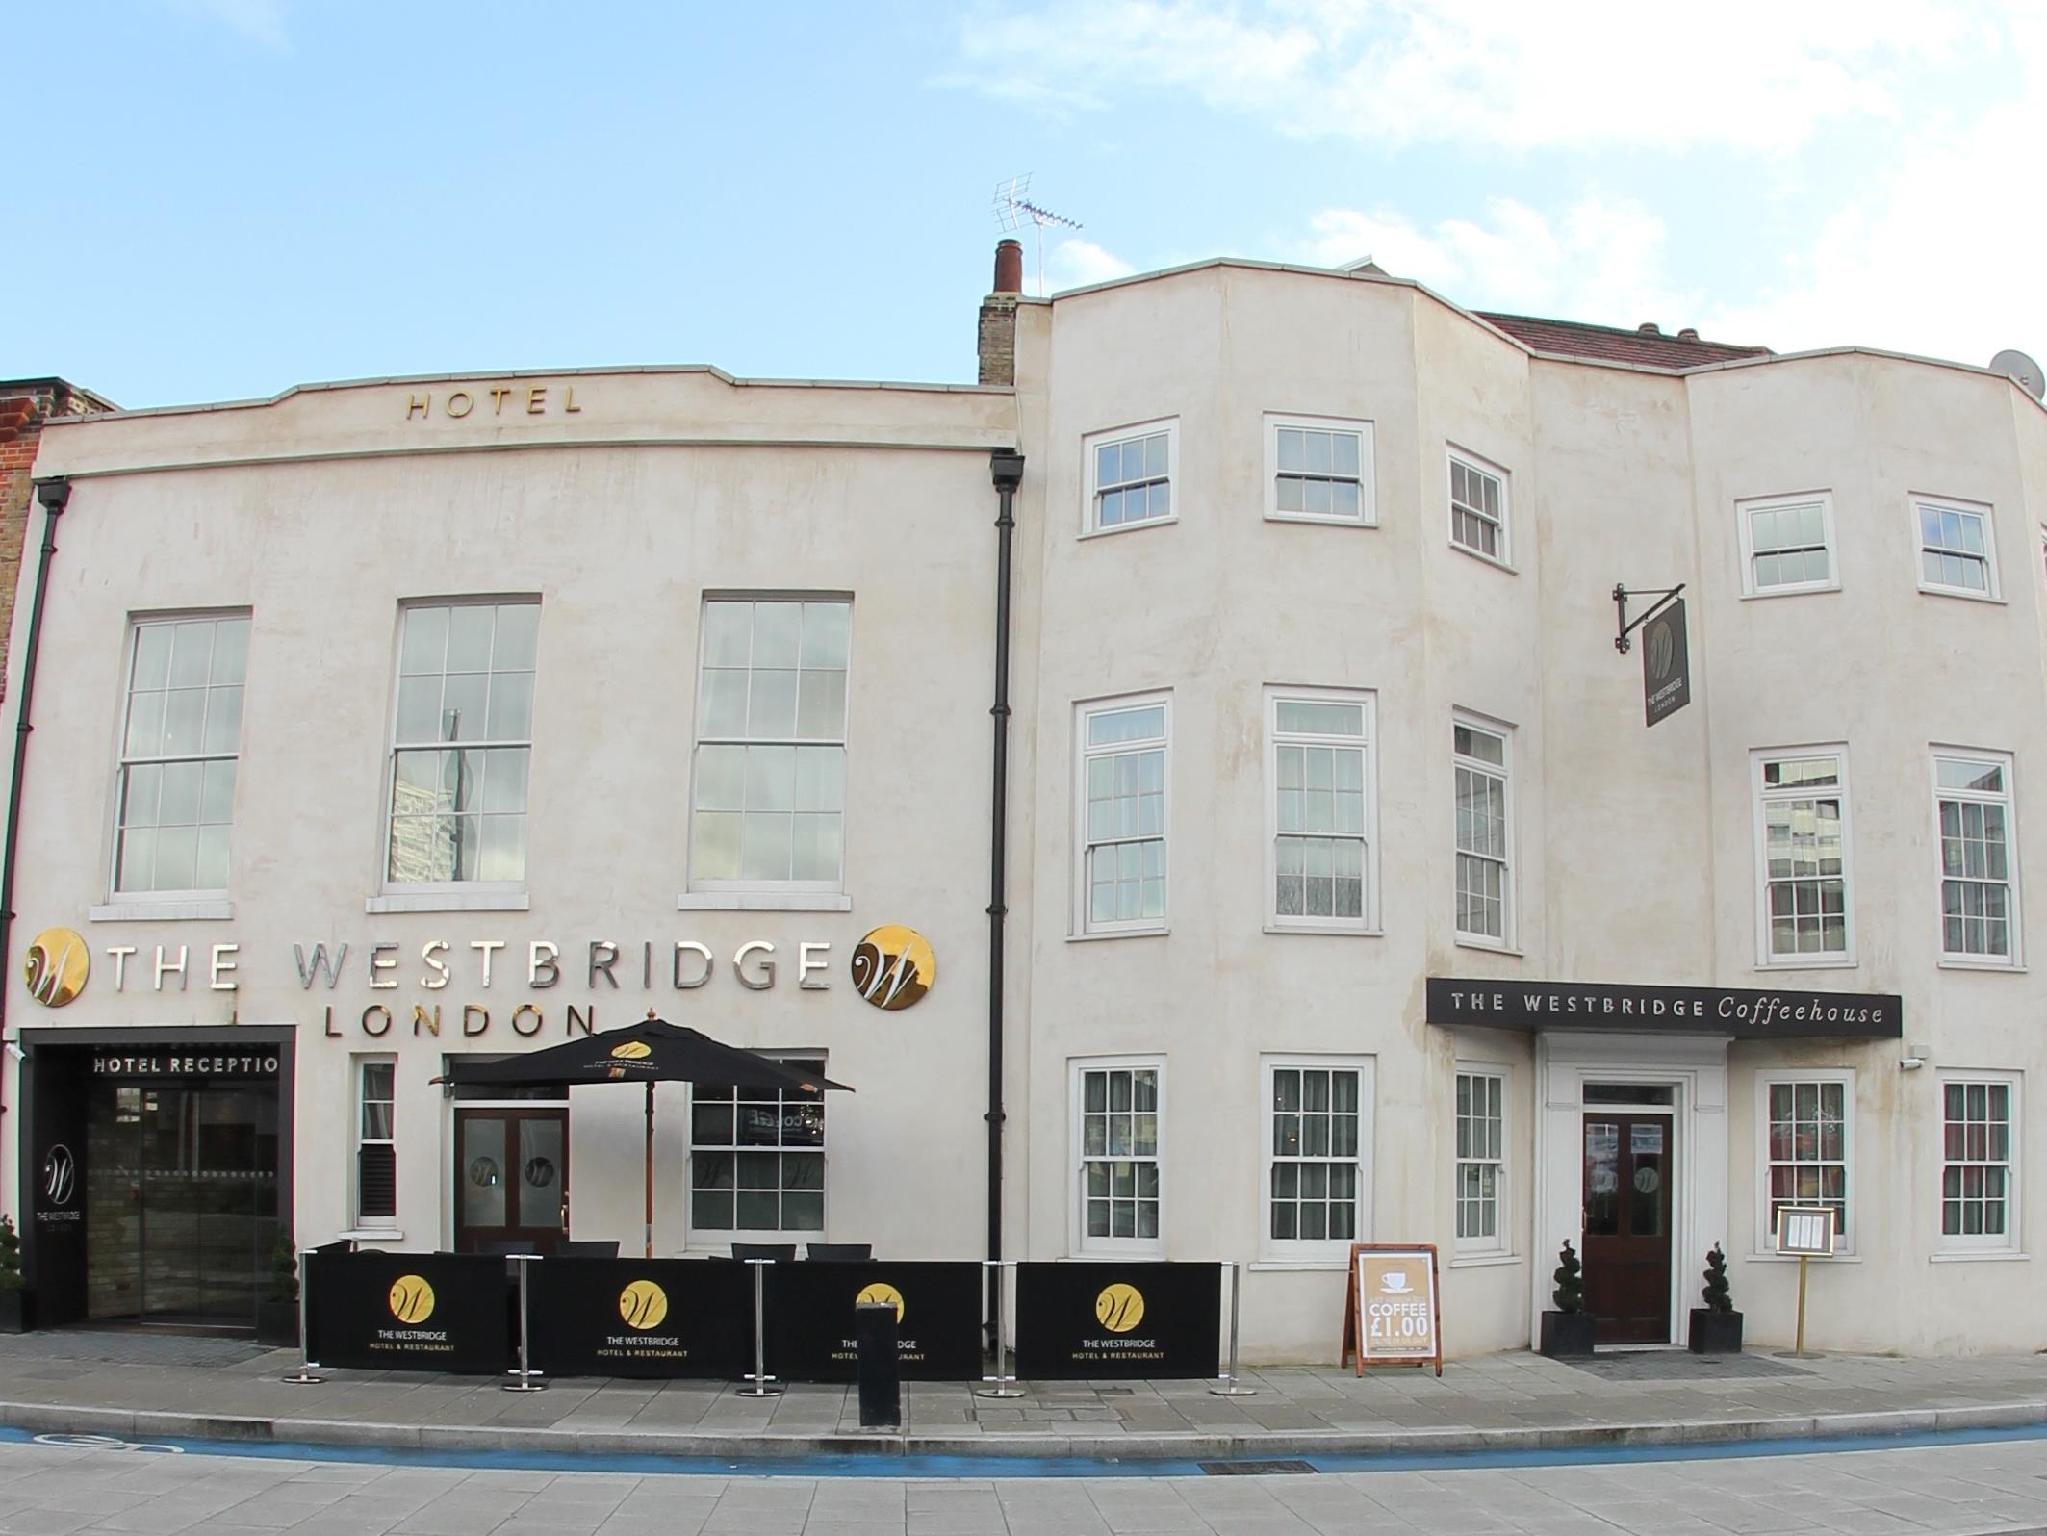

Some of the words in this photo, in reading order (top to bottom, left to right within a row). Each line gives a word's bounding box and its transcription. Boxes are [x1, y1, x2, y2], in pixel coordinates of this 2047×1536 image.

[406, 385, 581, 420] HOTEL
[106, 943, 240, 992] THE
[294, 940, 831, 990] WESTBRIDGE
[1451, 992, 1504, 1011] THE
[1523, 994, 1703, 1017] WESTBRIDGE
[1717, 996, 1883, 1025] Coffeehouse
[325, 1004, 594, 1038] LONDON
[94, 1057, 161, 1073] HOTEL
[169, 1057, 278, 1073] RECEPTIO
[1369, 1303, 1427, 1317] COFFEE
[1370, 1317, 1428, 1337] £1.00
[377, 1329, 394, 1340] THE
[394, 1329, 447, 1341] WESTBRIDGE
[607, 1336, 624, 1346] THE
[625, 1336, 679, 1347] WESTBRIDGE
[1083, 1339, 1099, 1348] THE
[1100, 1339, 1155, 1348] WESTBRIDGE
[597, 1349, 624, 1357] HOTEL
[1072, 1352, 1099, 1360] HOTEL
